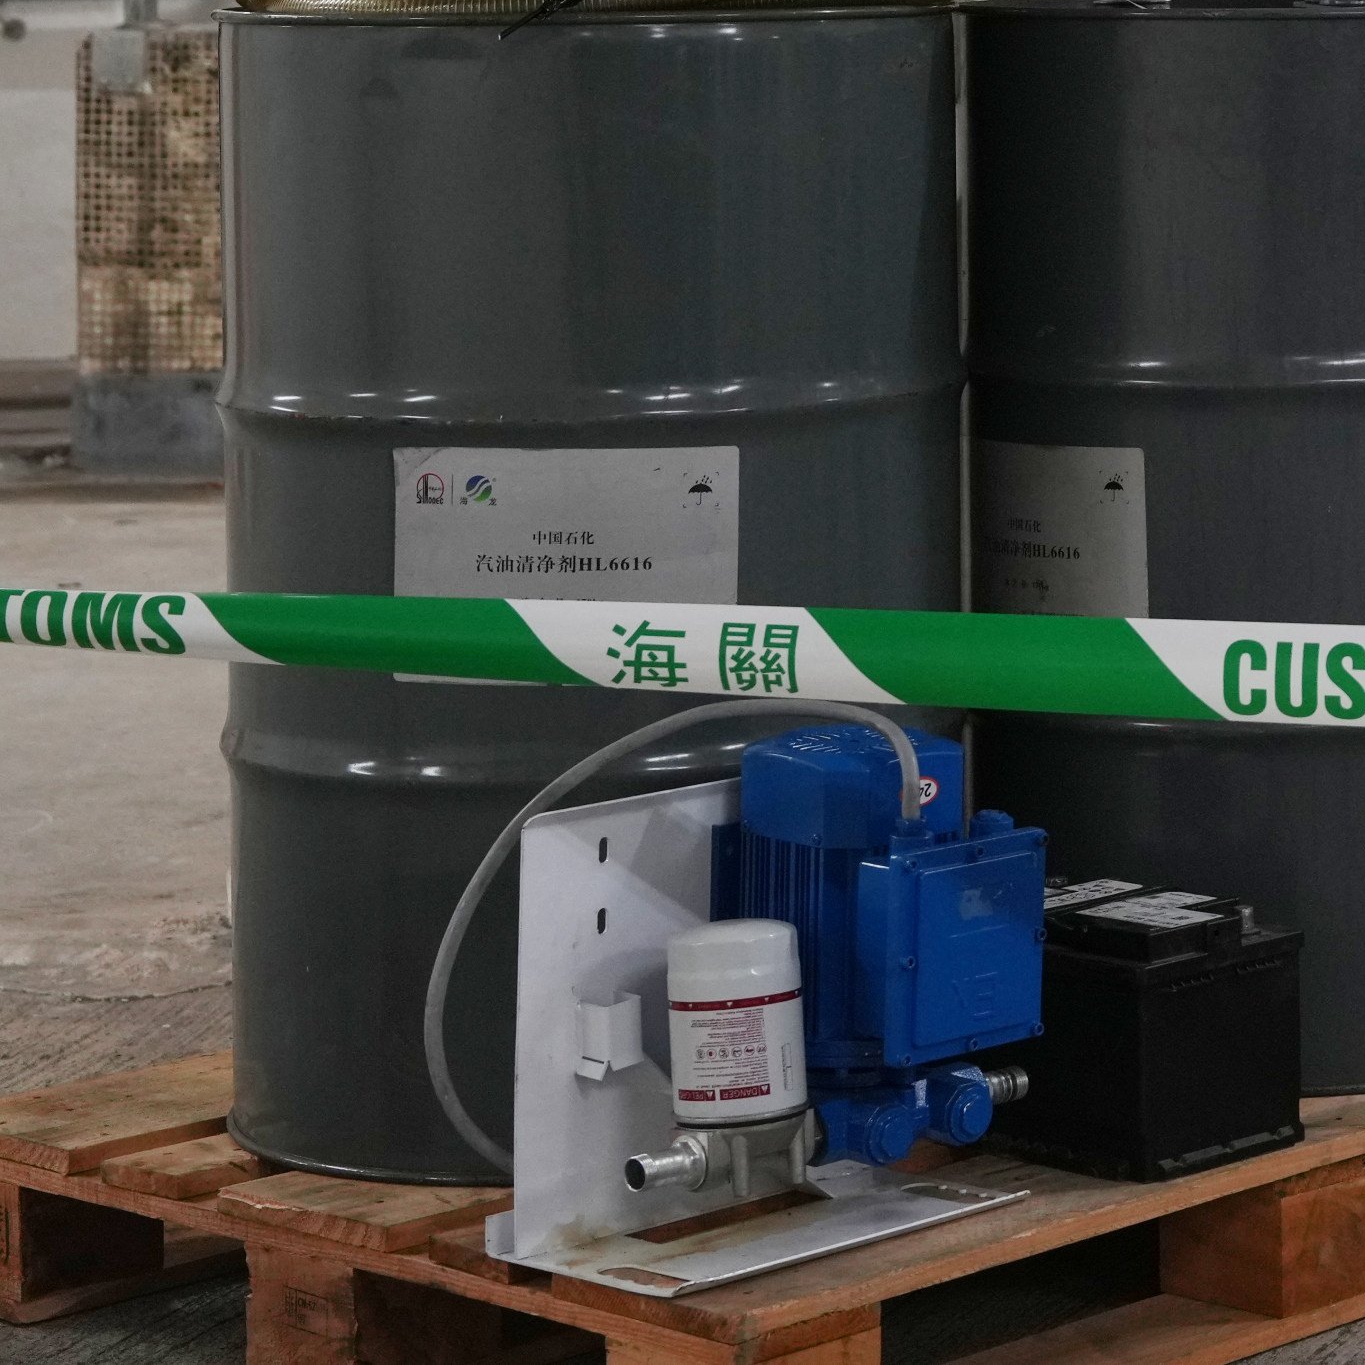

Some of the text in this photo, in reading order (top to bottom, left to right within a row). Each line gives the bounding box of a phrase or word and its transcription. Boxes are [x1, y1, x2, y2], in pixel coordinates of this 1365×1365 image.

[532, 529, 596, 546] 中国石化
[475, 553, 654, 574] 汽油清净剂HL6616
[607, 620, 800, 694] 海關
[722, 1087, 758, 1099] DANGER
